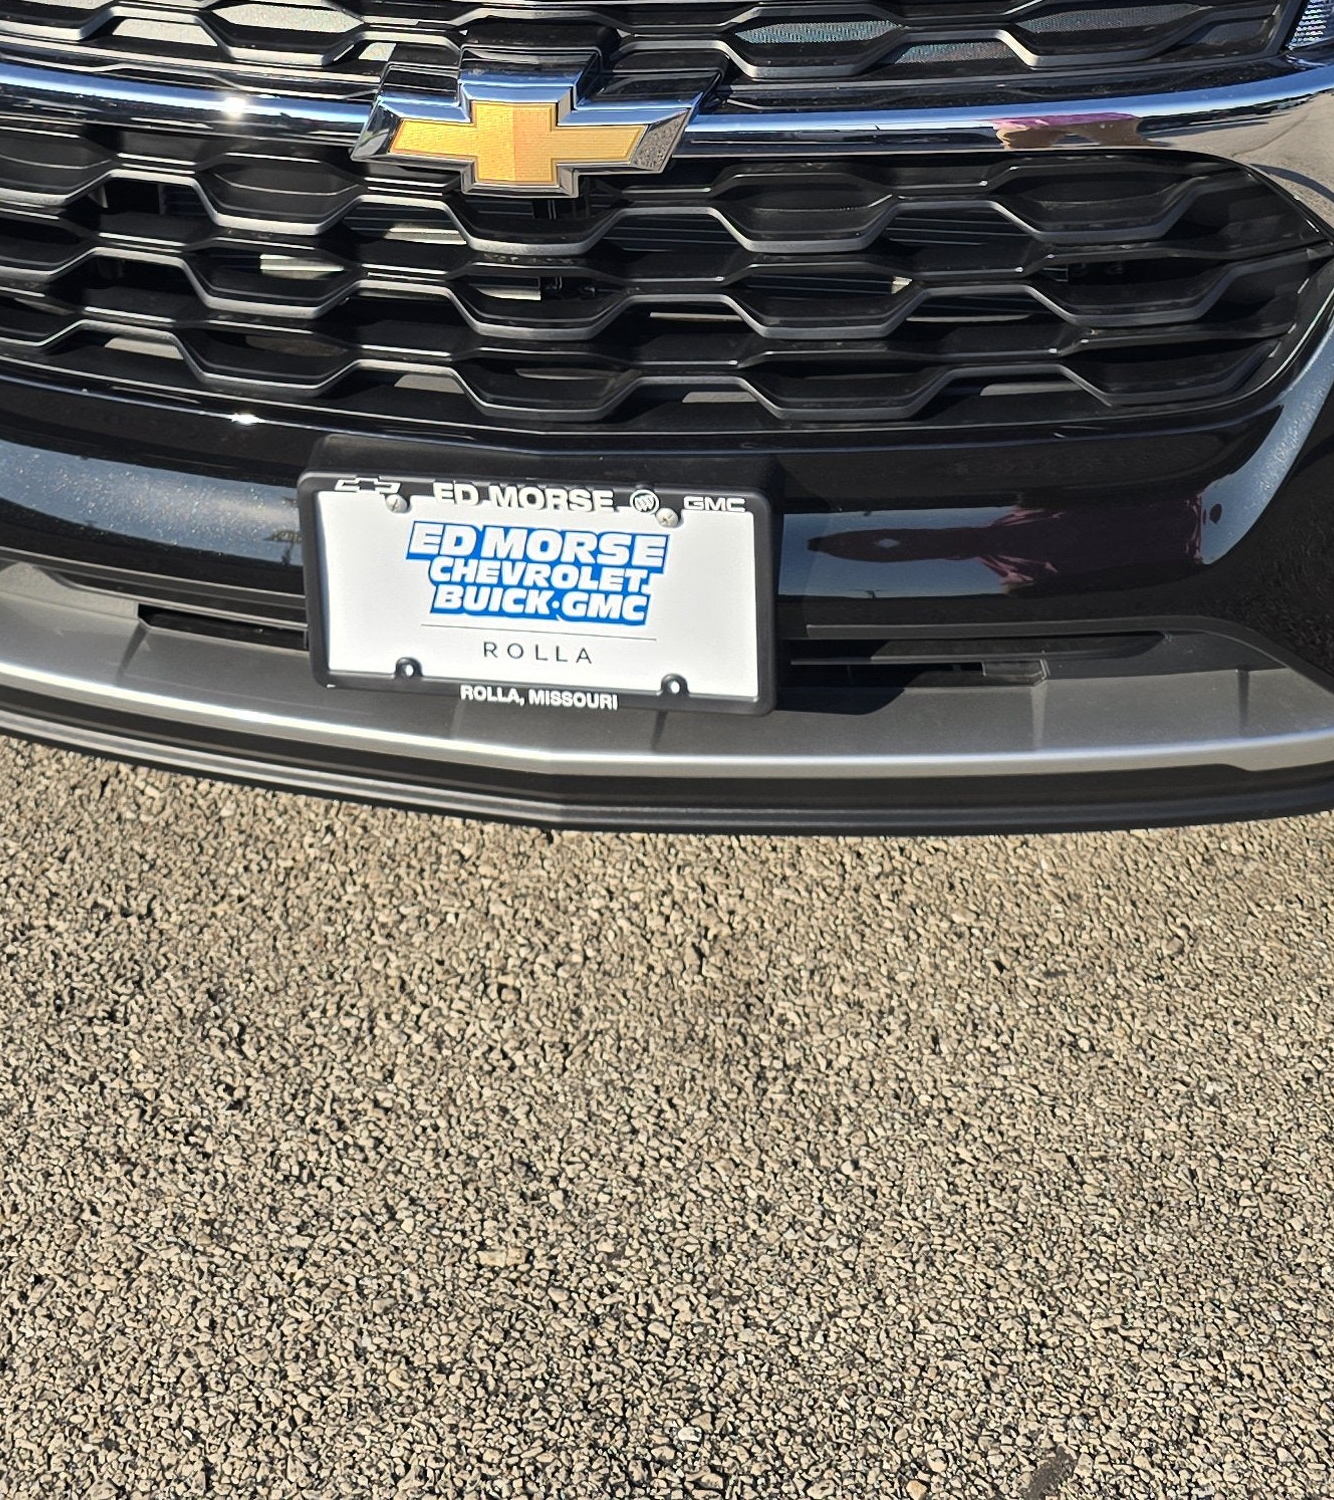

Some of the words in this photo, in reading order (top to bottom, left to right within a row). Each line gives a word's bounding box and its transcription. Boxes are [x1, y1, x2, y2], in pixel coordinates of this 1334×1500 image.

[433, 481, 480, 507] ED
[488, 484, 615, 513] MORSE
[683, 495, 746, 512] GMC
[408, 522, 478, 557] ED
[479, 526, 667, 568] MORSE
[429, 555, 648, 593] CHEVROLET
[483, 640, 593, 664] ROLLA
[459, 684, 525, 706] ROLLA,
[527, 688, 619, 711] MISSOURI
